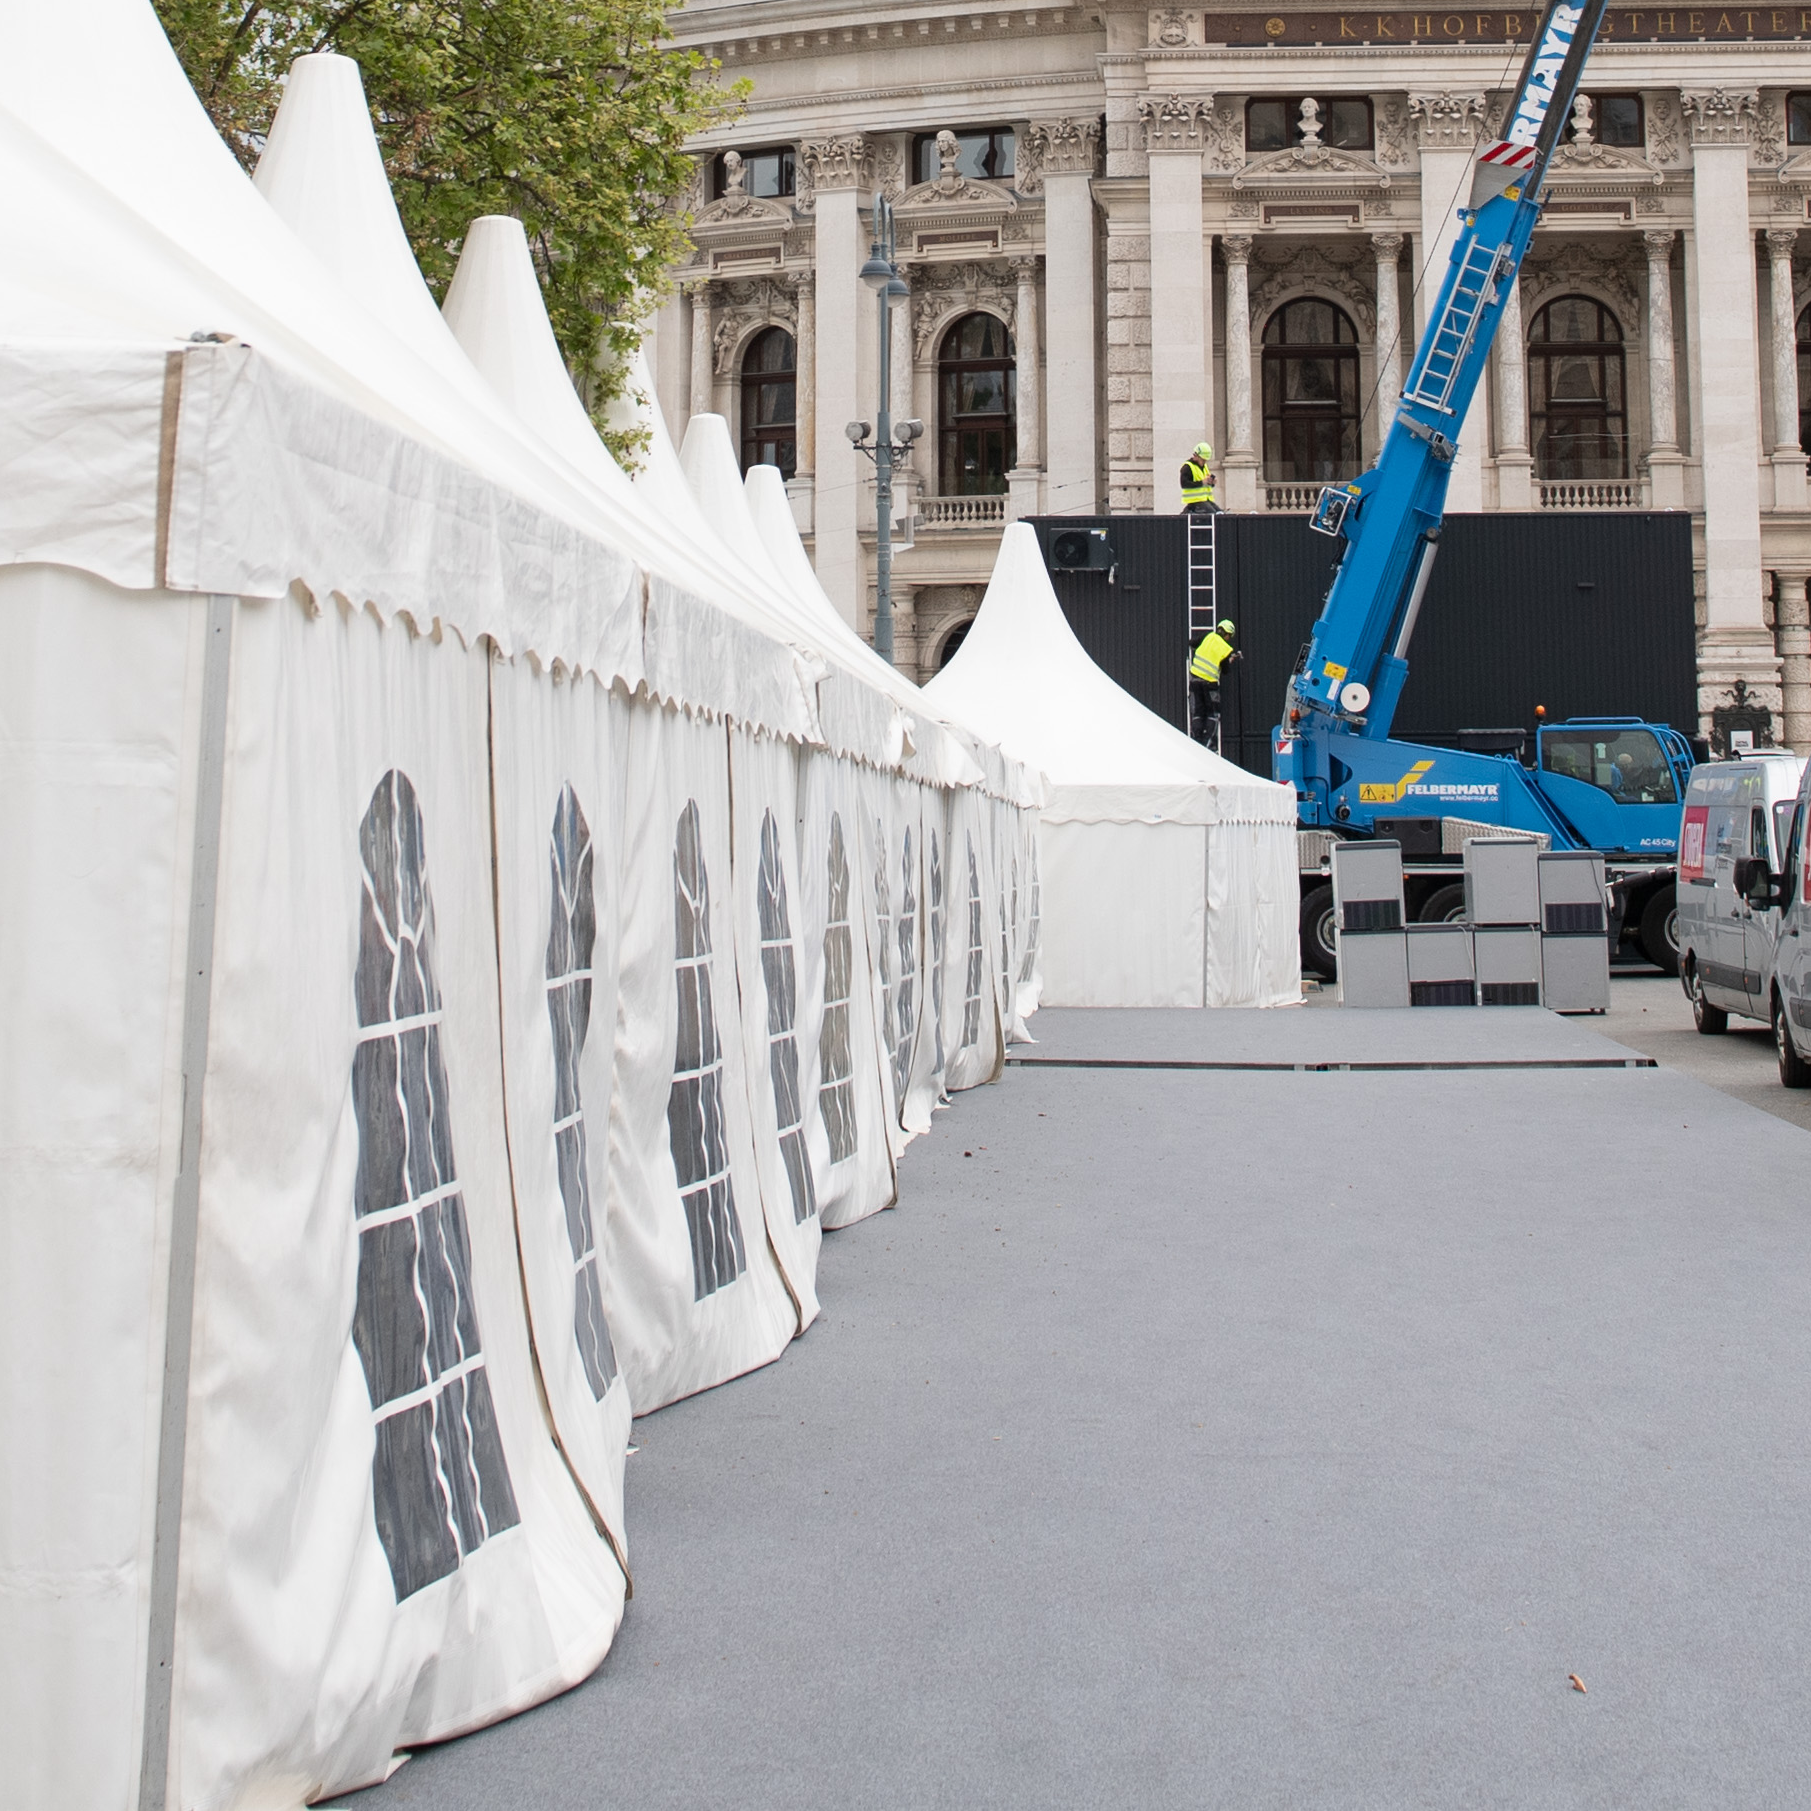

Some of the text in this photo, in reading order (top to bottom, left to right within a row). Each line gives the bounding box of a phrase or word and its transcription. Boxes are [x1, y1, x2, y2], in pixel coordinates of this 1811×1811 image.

[1407, 784, 1499, 795] FELBERMAYR
[1640, 838, 1650, 846] AC
[1661, 838, 1676, 847] City
